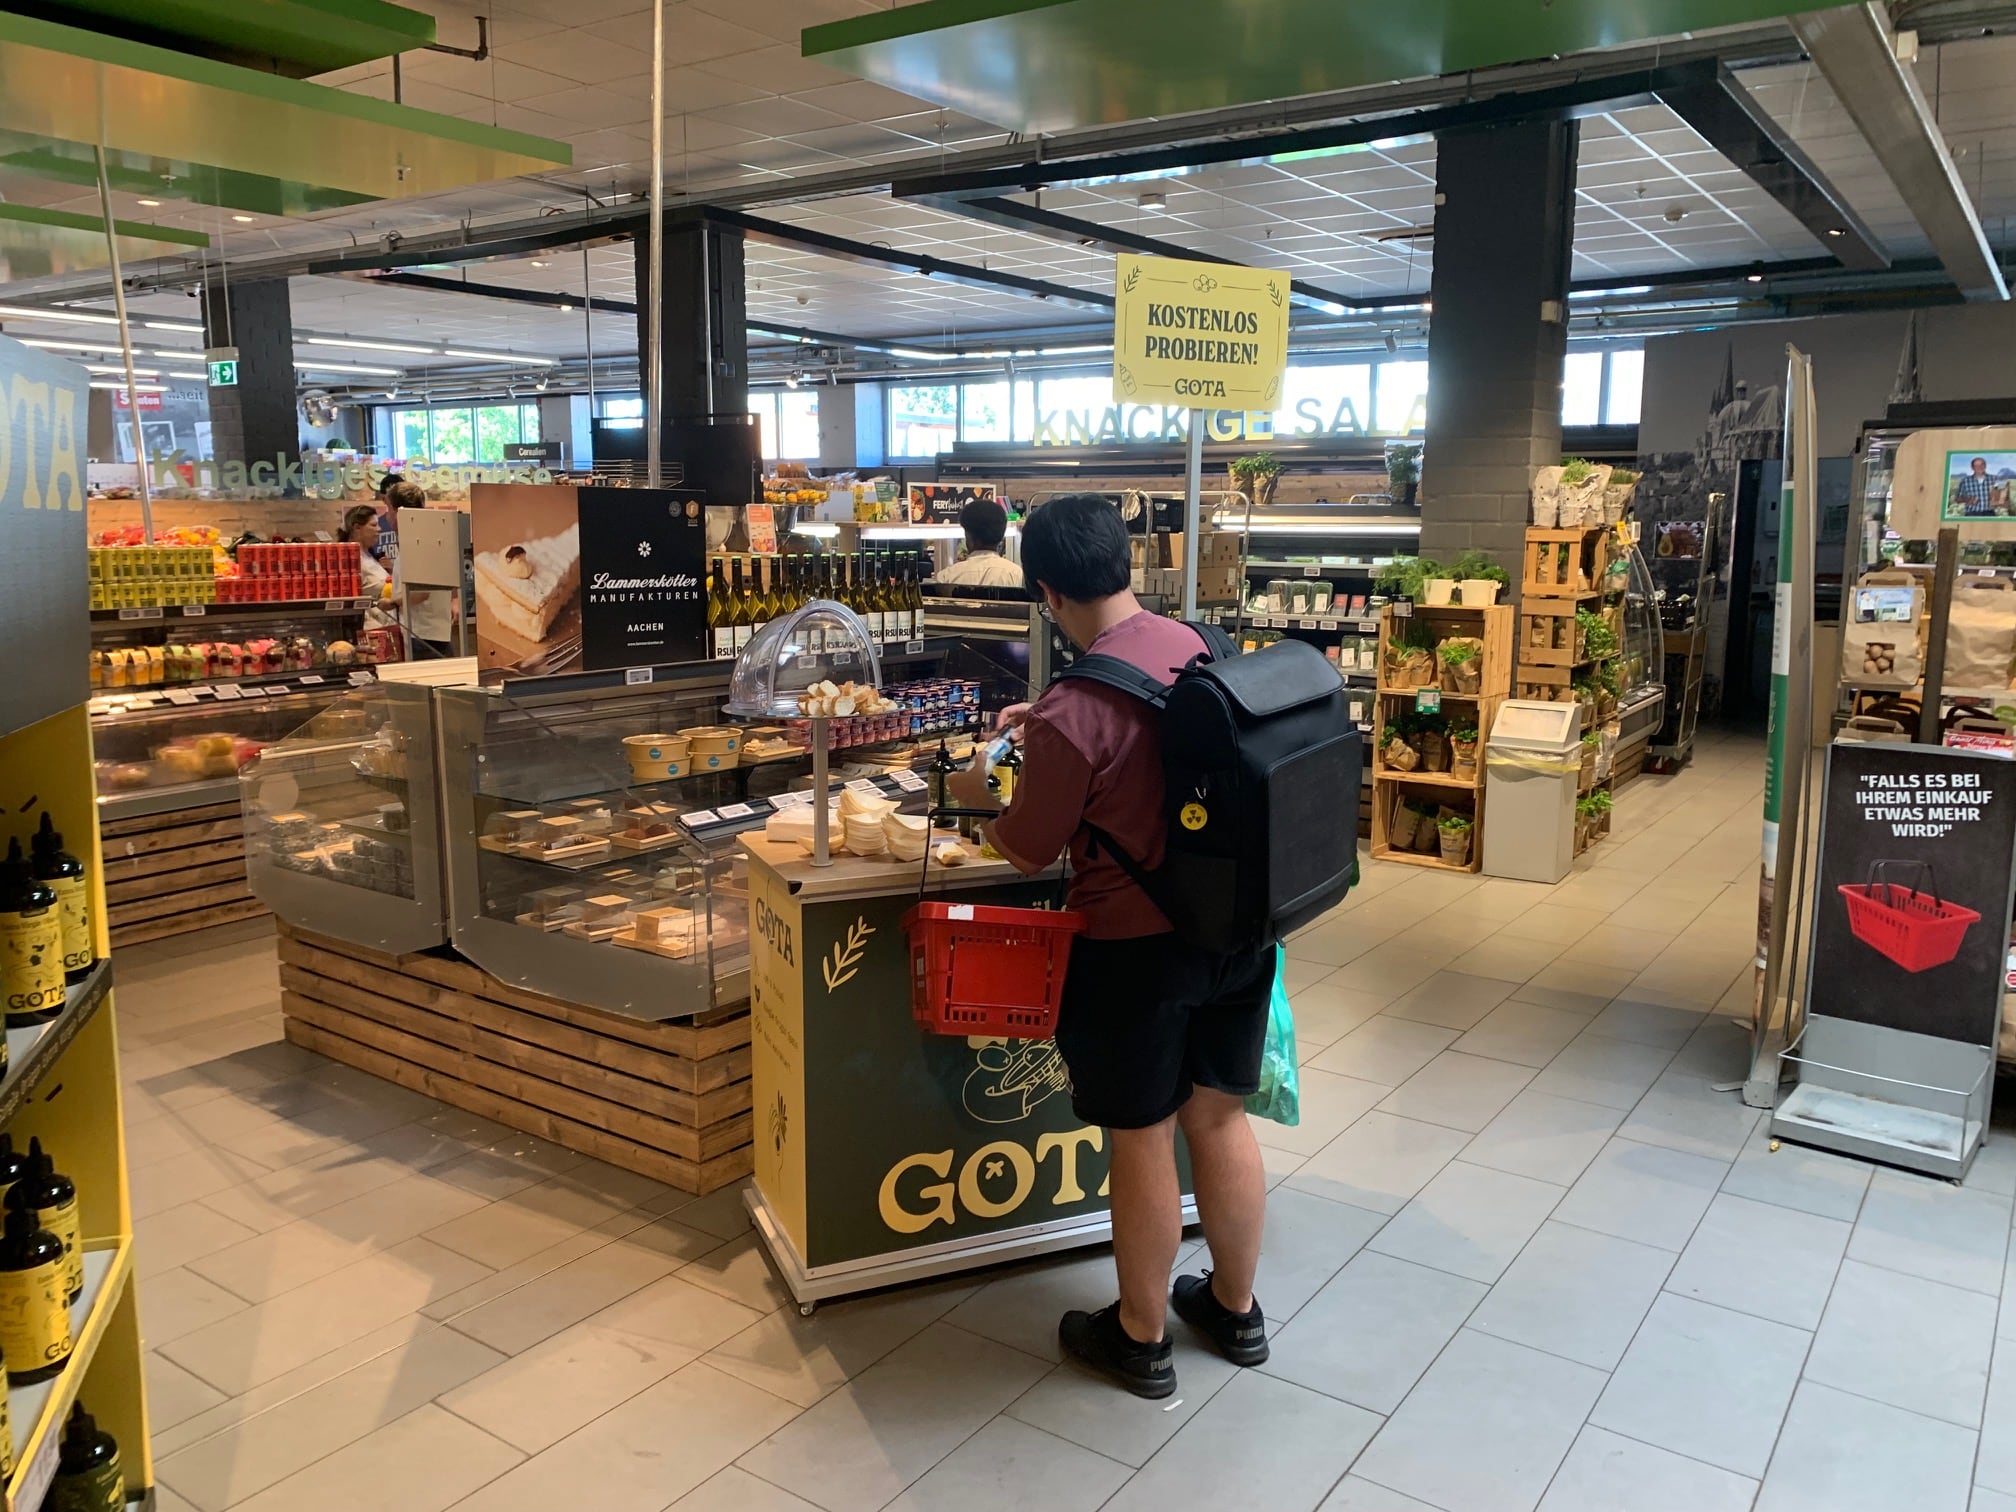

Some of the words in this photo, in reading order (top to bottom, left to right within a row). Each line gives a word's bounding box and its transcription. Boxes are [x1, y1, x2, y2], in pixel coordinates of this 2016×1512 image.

[1148, 303, 1258, 334] KOSTENLOS
[1145, 335, 1259, 365] PROBIEREN!
[1174, 378, 1226, 397] GOTA
[1033, 403, 1274, 447] KNACKGE
[590, 572, 698, 590] Lammerskötter
[590, 591, 698, 603] MANUFAKTUREN
[627, 623, 664, 633] AACHEN
[1860, 774, 1920, 788] "FALLS
[1925, 774, 1947, 788] ES
[1951, 773, 1980, 788] BEI
[1856, 791, 1912, 804] IHREM
[1915, 790, 1993, 804] EINKAUF
[1864, 807, 1924, 821] ETWAS
[1928, 807, 1981, 821] MEHR
[1891, 823, 1953, 837] WIRD!"
[755, 896, 795, 968] GOTA
[878, 1124, 1110, 1234] GOT
[1236, 1326, 1263, 1340] PUMA
